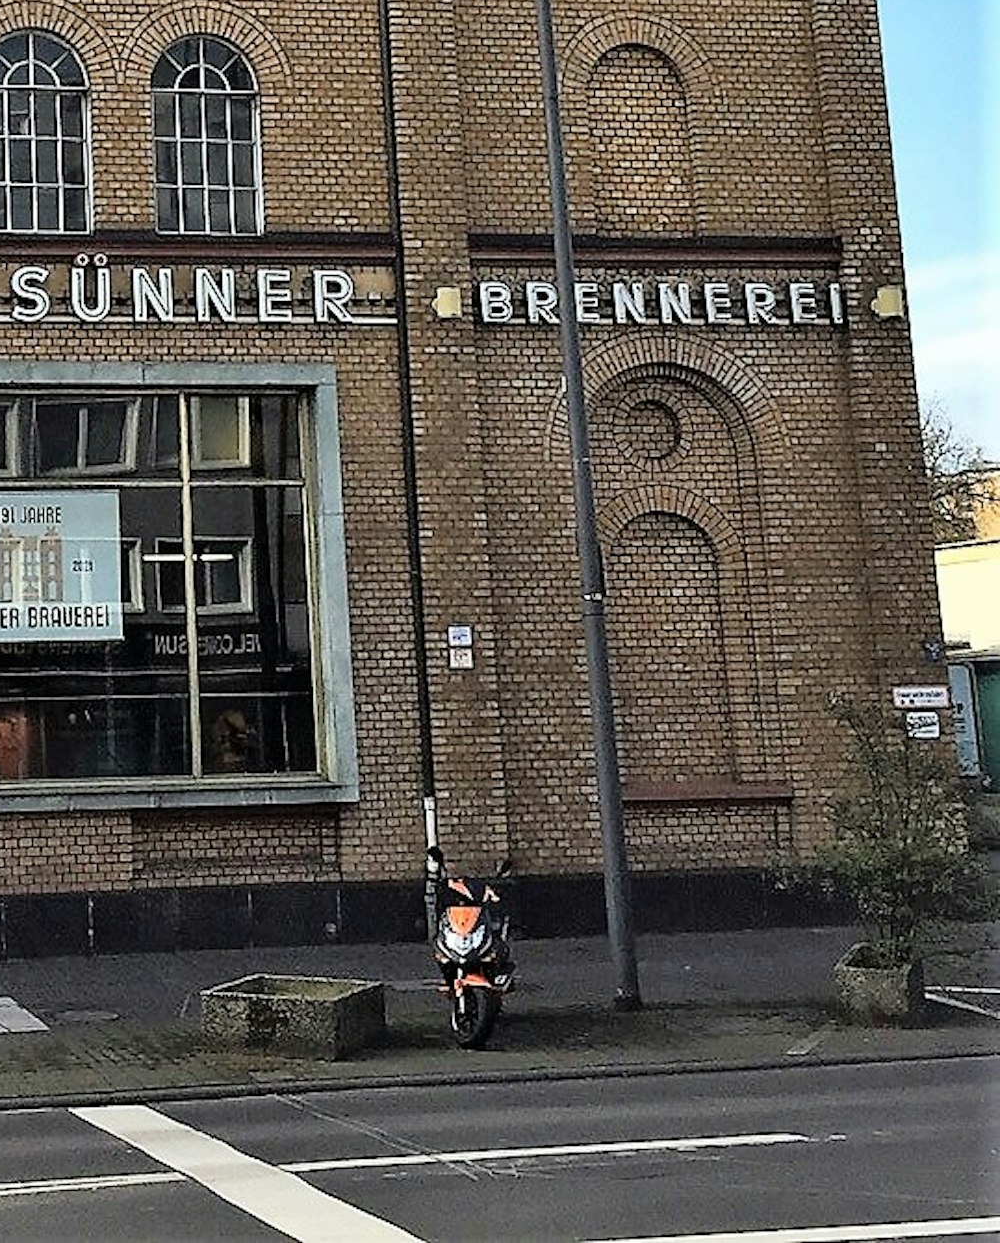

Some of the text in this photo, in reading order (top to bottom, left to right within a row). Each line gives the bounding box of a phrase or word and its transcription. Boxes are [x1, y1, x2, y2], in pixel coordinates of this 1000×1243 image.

[11, 253, 355, 323] SÜNNER
[479, 281, 844, 324] BRENNEREI
[20, 506, 62, 524] JAHRE
[28, 604, 110, 628] BRAUEREI
